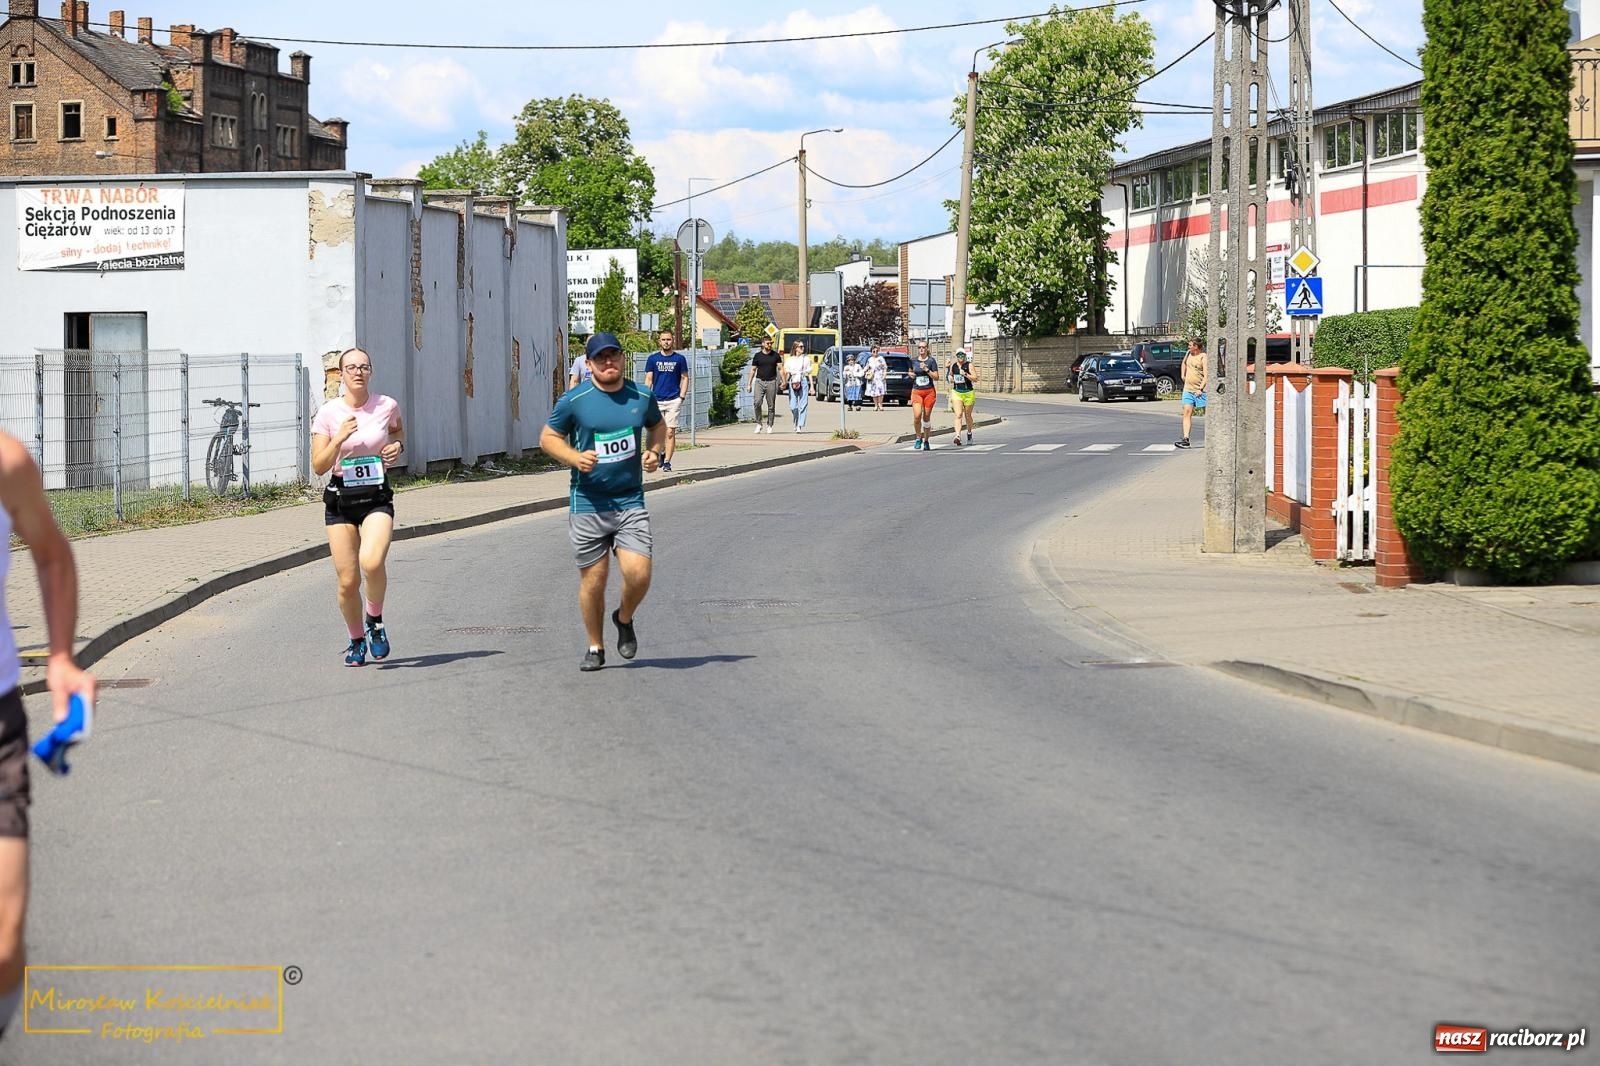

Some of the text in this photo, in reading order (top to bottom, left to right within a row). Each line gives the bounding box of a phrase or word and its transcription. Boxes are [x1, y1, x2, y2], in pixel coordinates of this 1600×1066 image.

[41, 183, 159, 204] TRWA NABÓR
[25, 205, 175, 224] Sekcja Podnoszenia
[25, 221, 92, 239] Ciężarów
[104, 225, 175, 235] wiek: od 13 do 17
[60, 247, 82, 258] silny
[93, 242, 122, 254] dodaj
[603, 438, 629, 455] 100
[355, 465, 371, 478] 81
